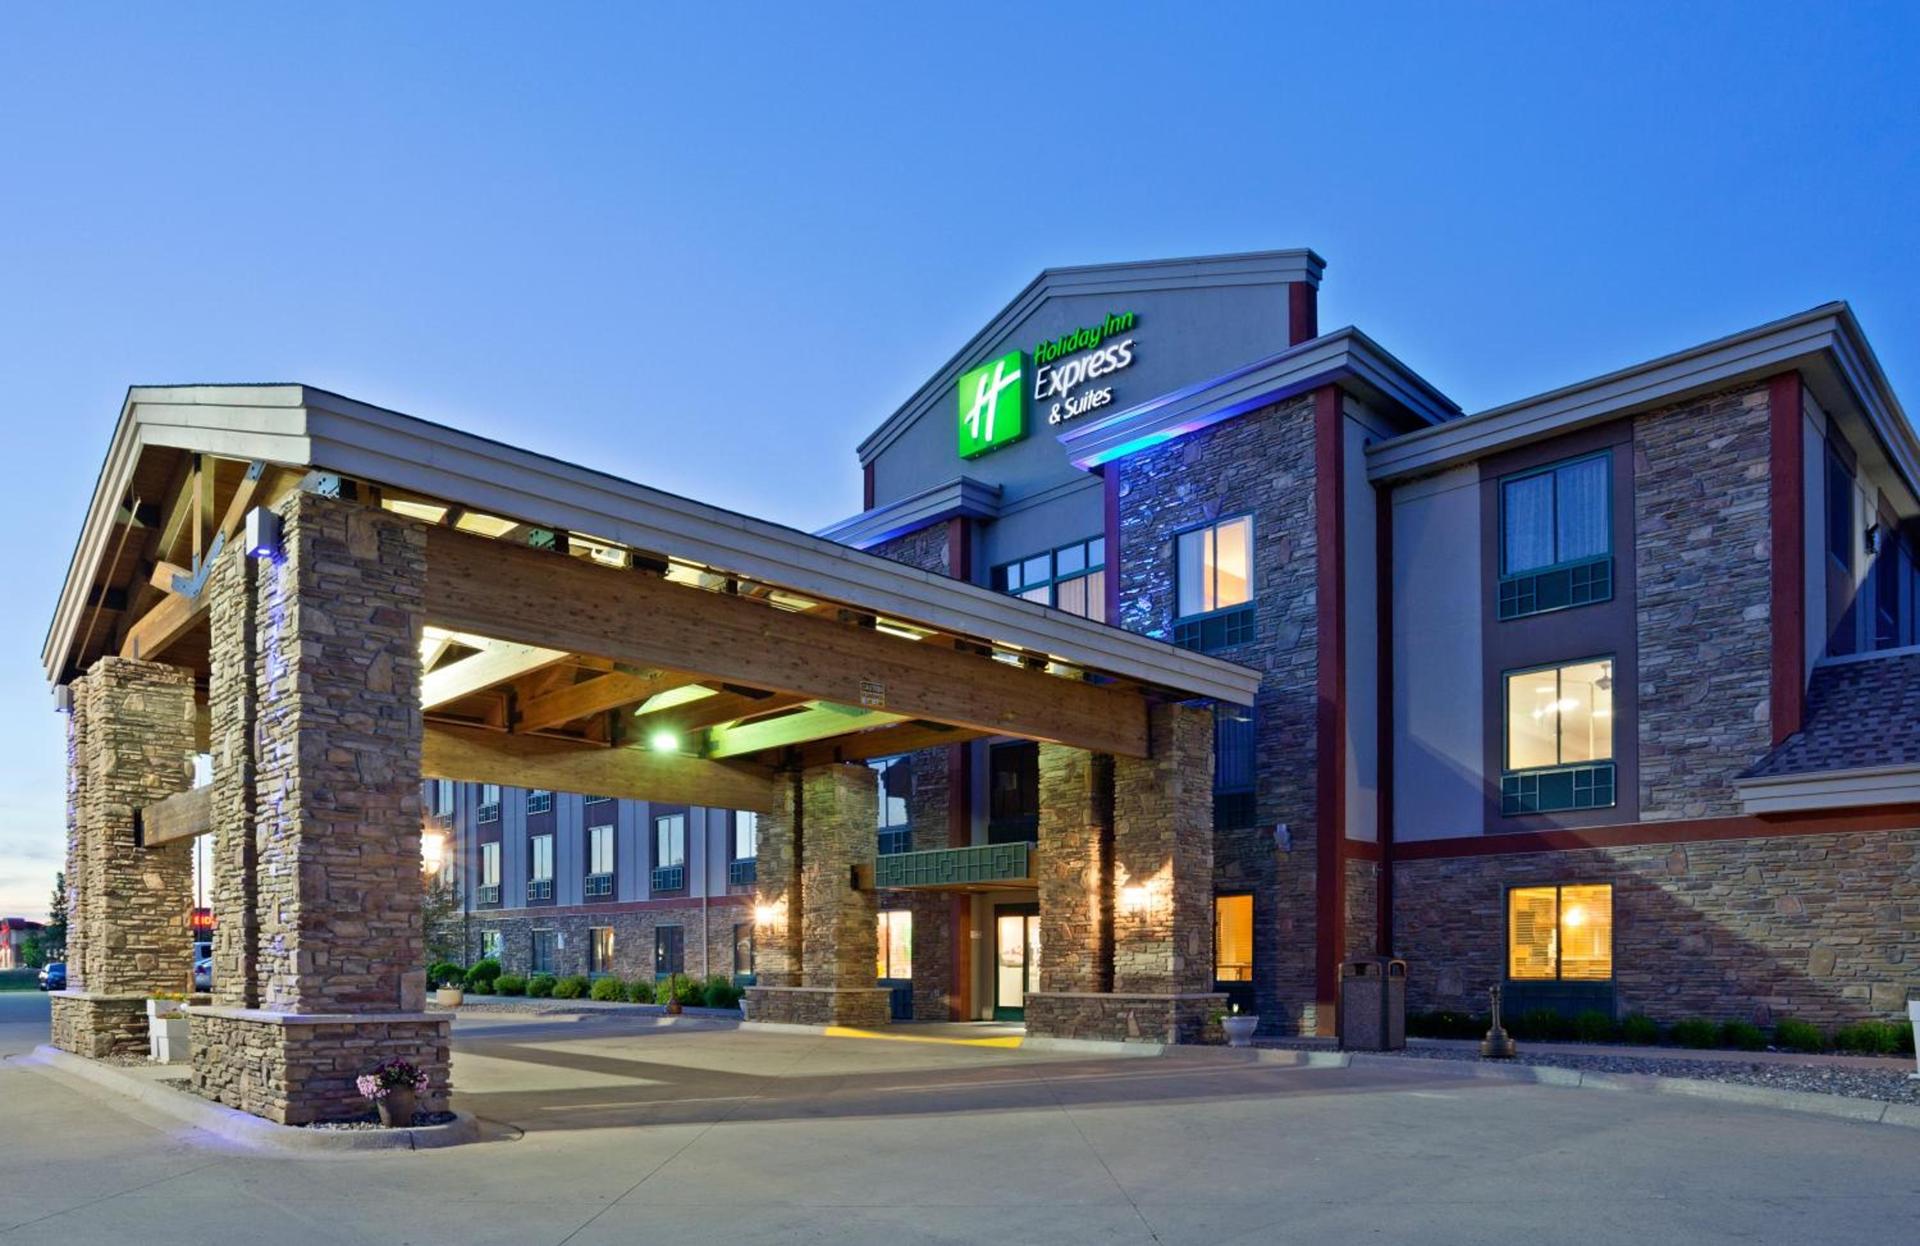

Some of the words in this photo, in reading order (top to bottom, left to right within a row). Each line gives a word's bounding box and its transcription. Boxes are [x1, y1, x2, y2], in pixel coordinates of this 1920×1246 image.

[1034, 326, 1102, 365] Holiday
[1104, 311, 1133, 337] Inn
[1034, 339, 1133, 400] Express
[1048, 403, 1061, 424] &
[1063, 387, 1112, 419] Suites
